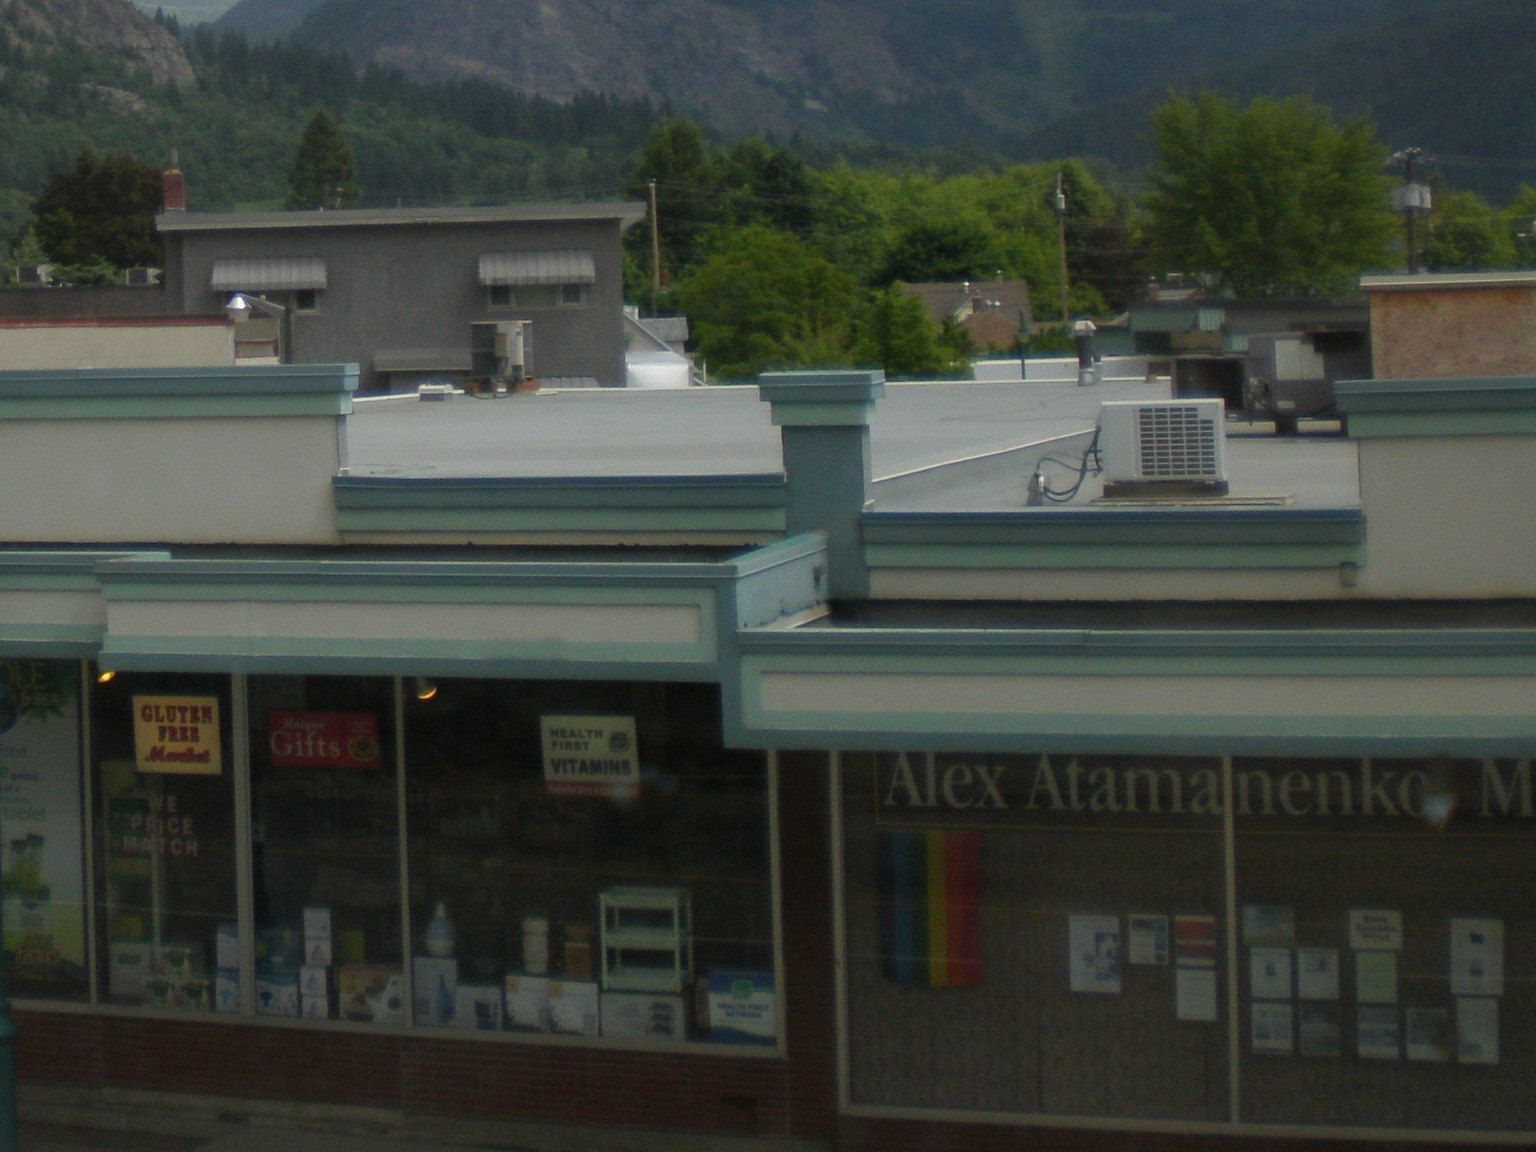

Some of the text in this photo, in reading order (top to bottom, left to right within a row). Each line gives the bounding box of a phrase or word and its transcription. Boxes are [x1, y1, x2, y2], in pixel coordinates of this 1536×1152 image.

[141, 705, 213, 724] GLUTEN
[158, 726, 199, 743] FREE
[550, 728, 603, 739] HEALTH
[270, 731, 341, 758] Gifts
[551, 740, 590, 751] FIRST
[550, 757, 632, 776] VITAMINS
[883, 754, 1010, 810] Alex
[148, 795, 178, 813] WE
[131, 813, 194, 836] PRICE
[123, 835, 199, 857] MATCH
